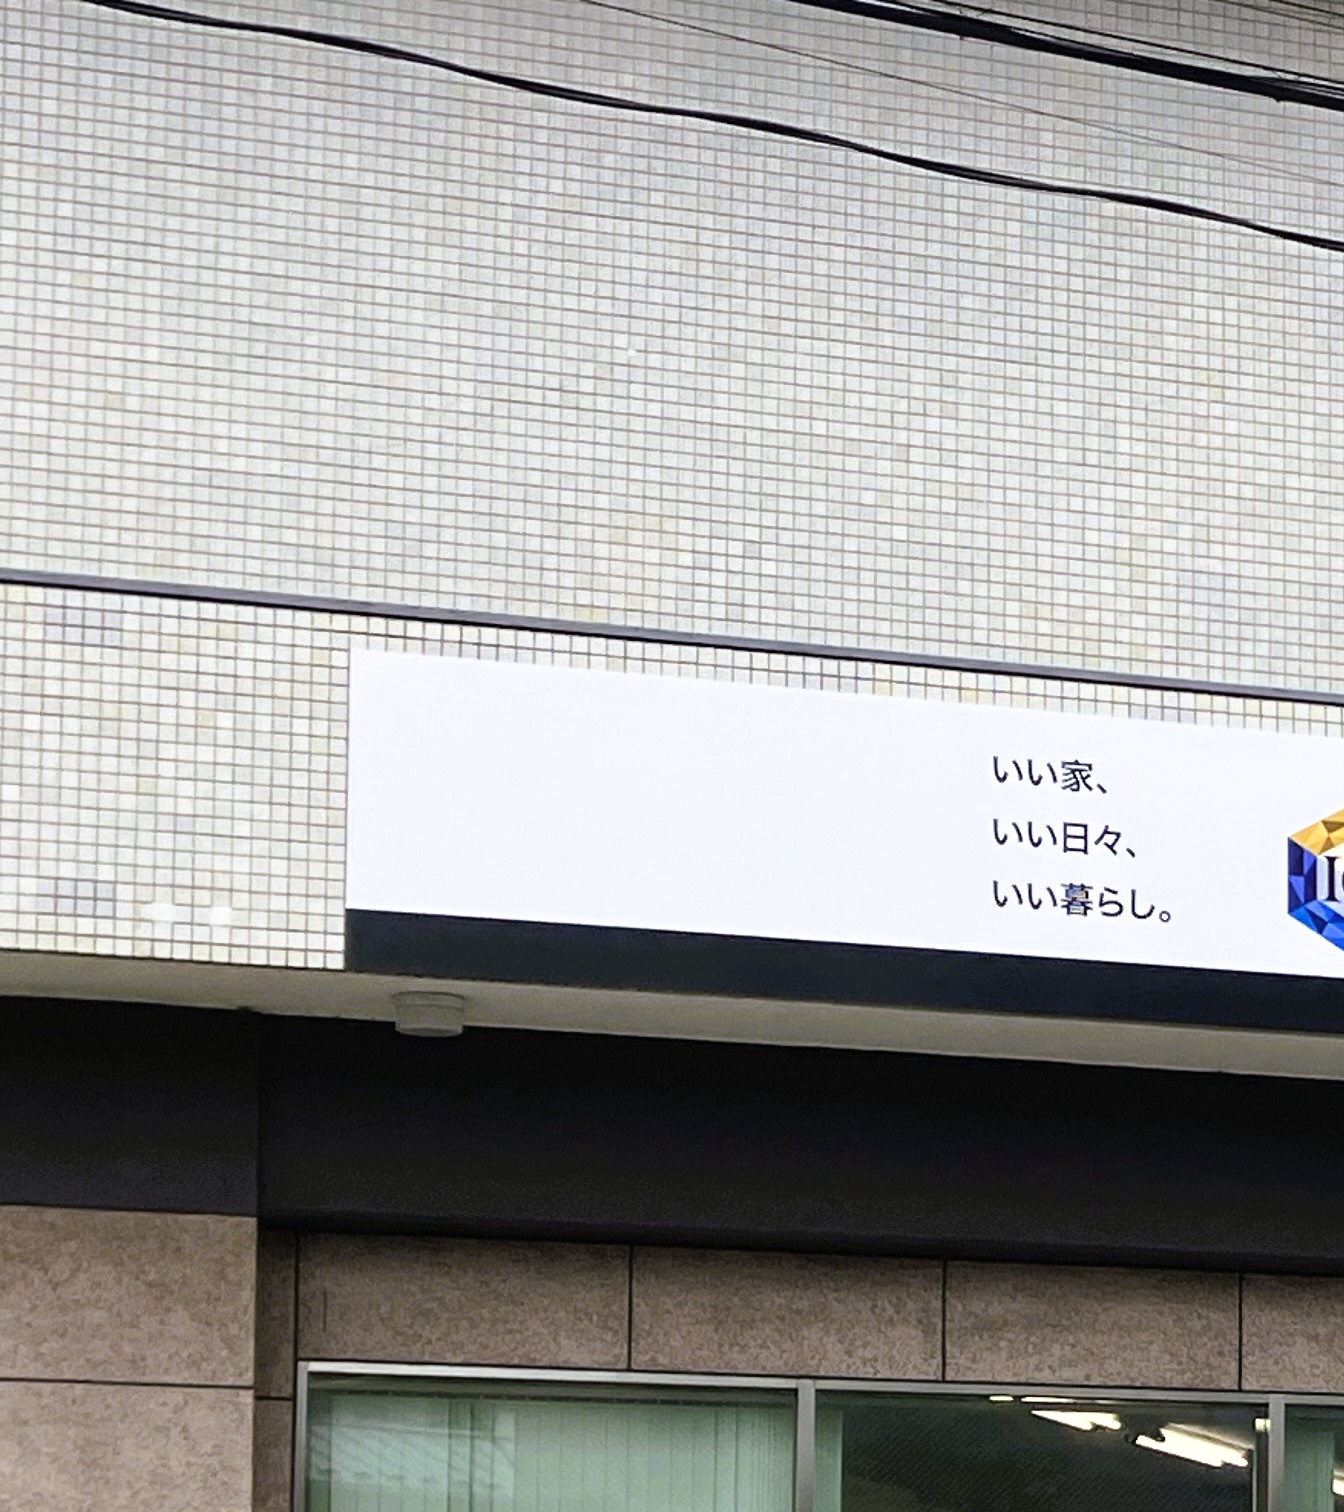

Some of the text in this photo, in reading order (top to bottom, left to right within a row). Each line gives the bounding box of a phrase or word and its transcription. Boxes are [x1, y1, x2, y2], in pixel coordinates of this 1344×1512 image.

[992, 755, 1108, 795] いい家、
[992, 817, 1138, 858] いい日々、
[992, 879, 1172, 924] いい暮らし。
